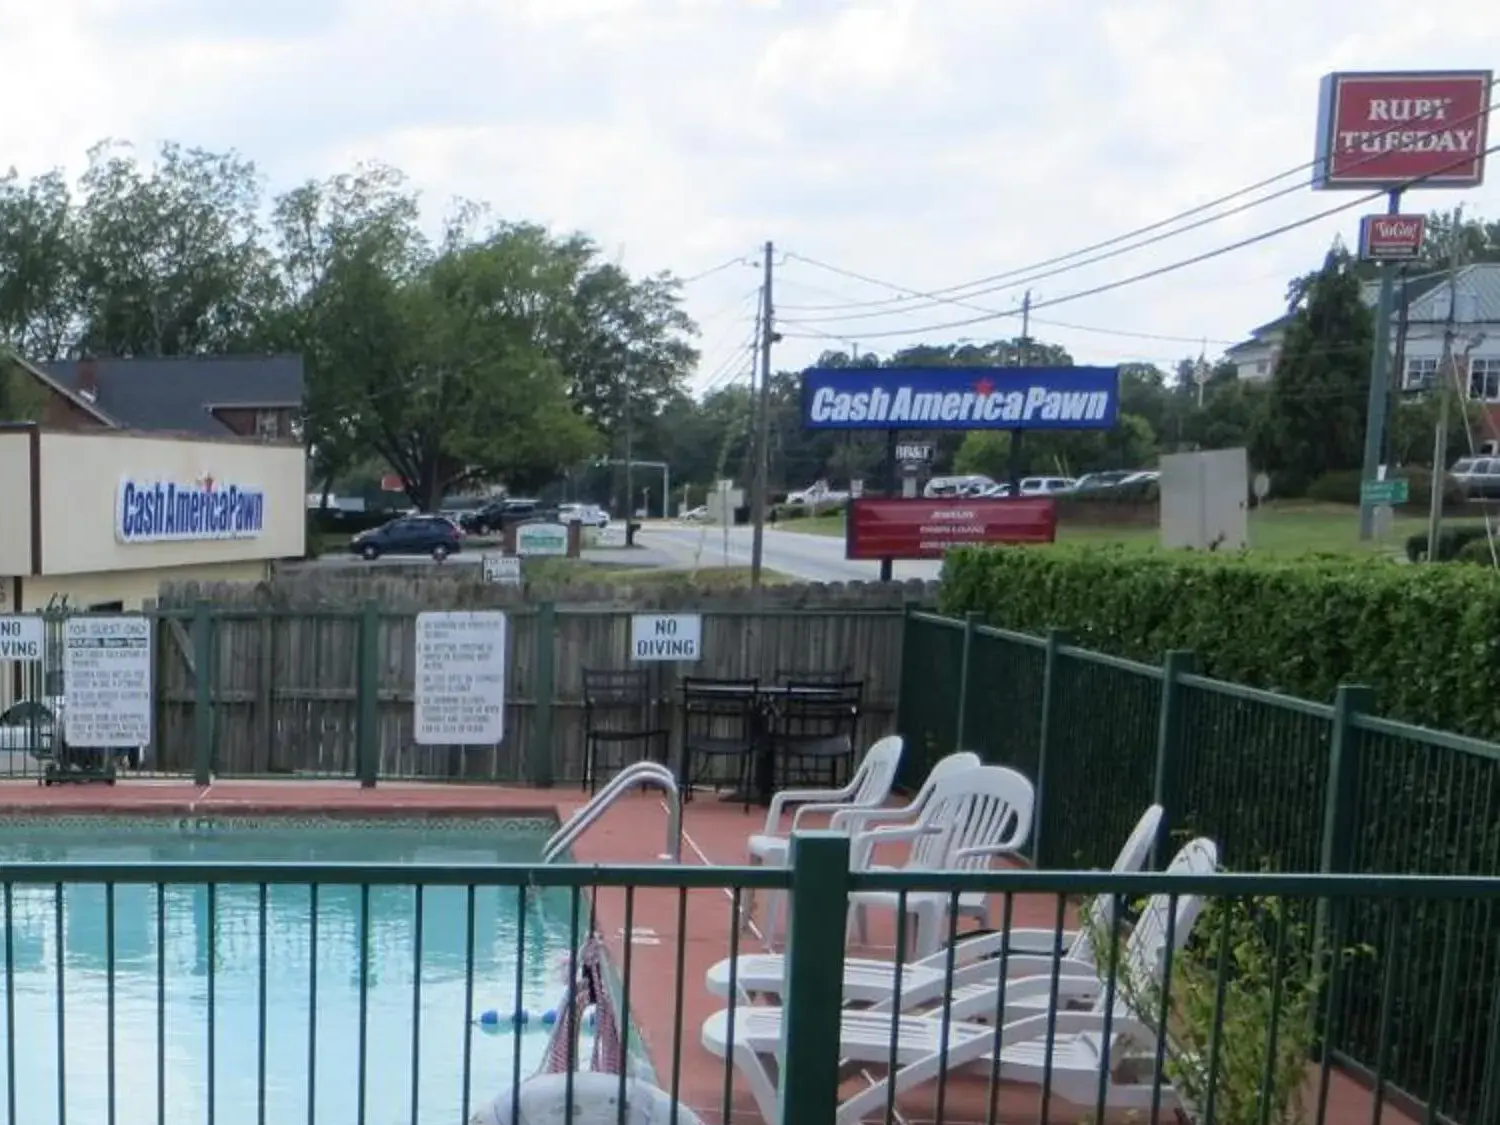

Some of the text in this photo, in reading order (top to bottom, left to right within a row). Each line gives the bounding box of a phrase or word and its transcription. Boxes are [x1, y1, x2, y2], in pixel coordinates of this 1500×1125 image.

[1367, 98, 1446, 121] RUBY
[1339, 129, 1475, 153] TUESDAY
[0, 621, 21, 637] NO
[654, 619, 677, 636] NO
[637, 639, 695, 657] DIVING
